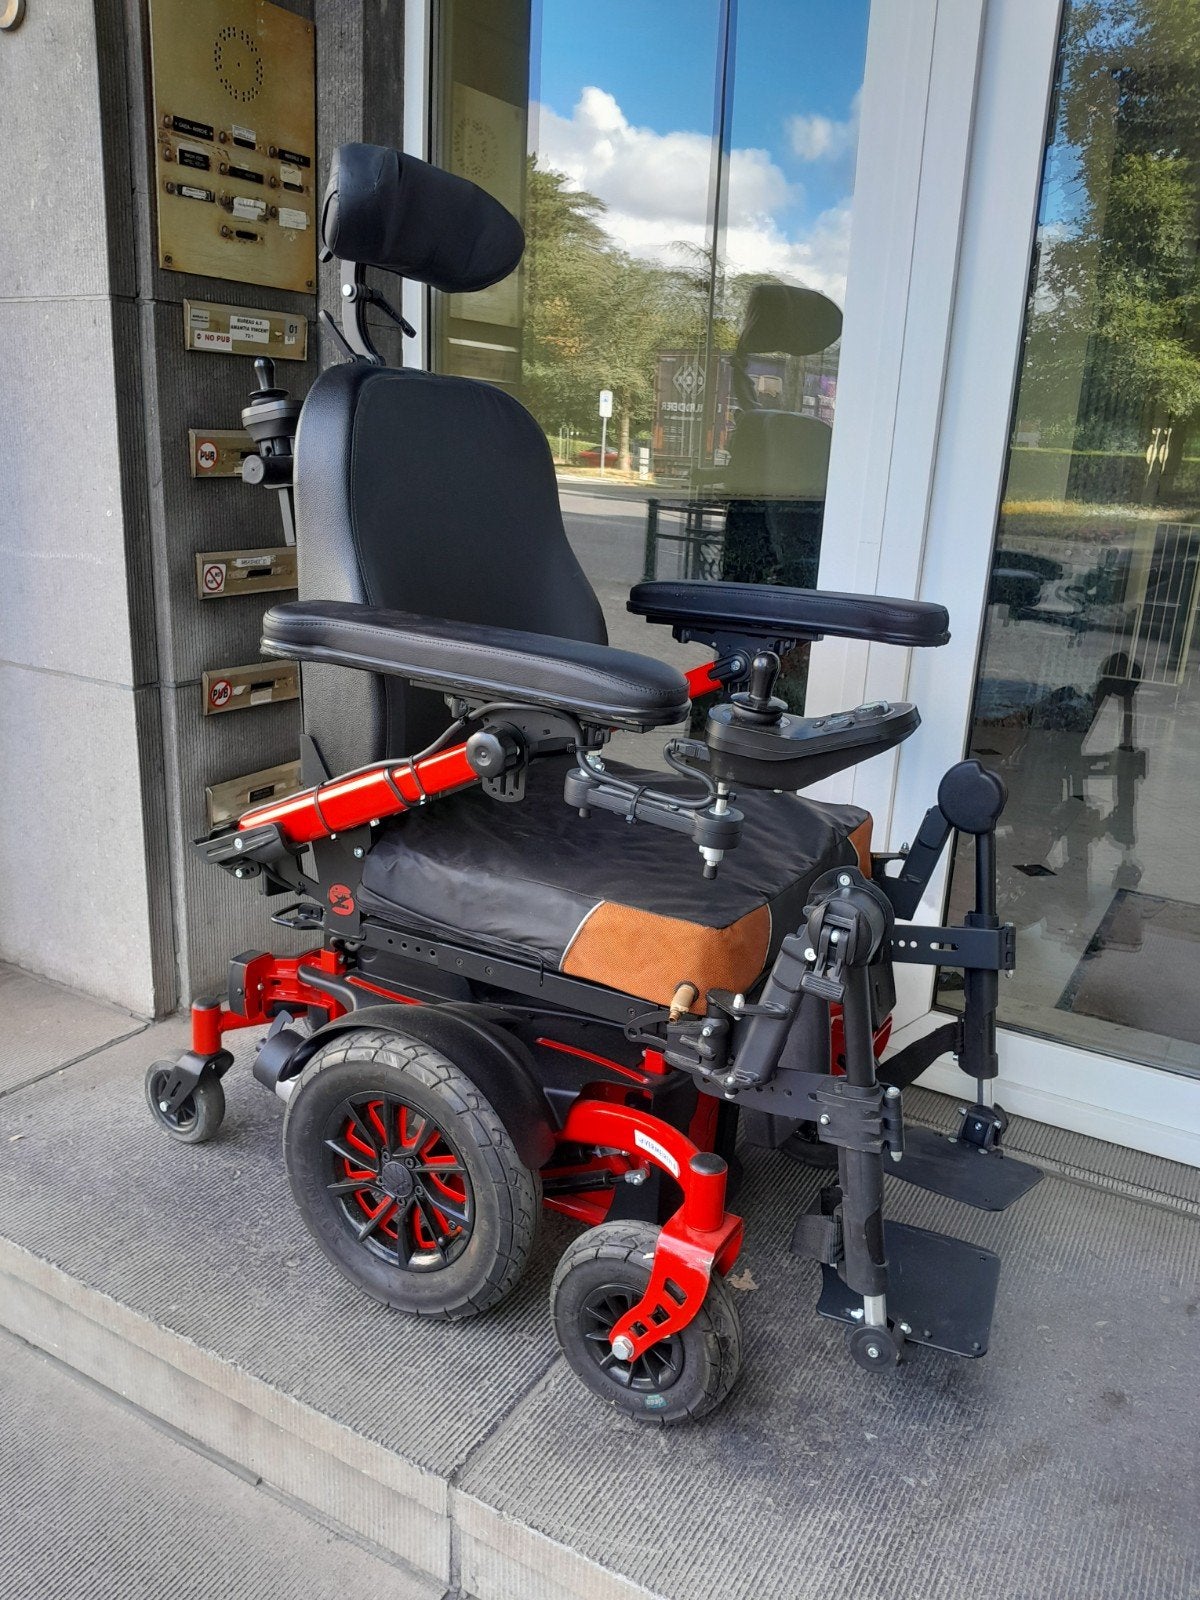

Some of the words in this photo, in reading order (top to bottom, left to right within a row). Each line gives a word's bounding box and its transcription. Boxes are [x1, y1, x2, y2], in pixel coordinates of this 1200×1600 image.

[289, 324, 298, 334] 01
[216, 335, 231, 343] PUB
[200, 450, 214, 460] PUB
[213, 687, 228, 699] PUB
